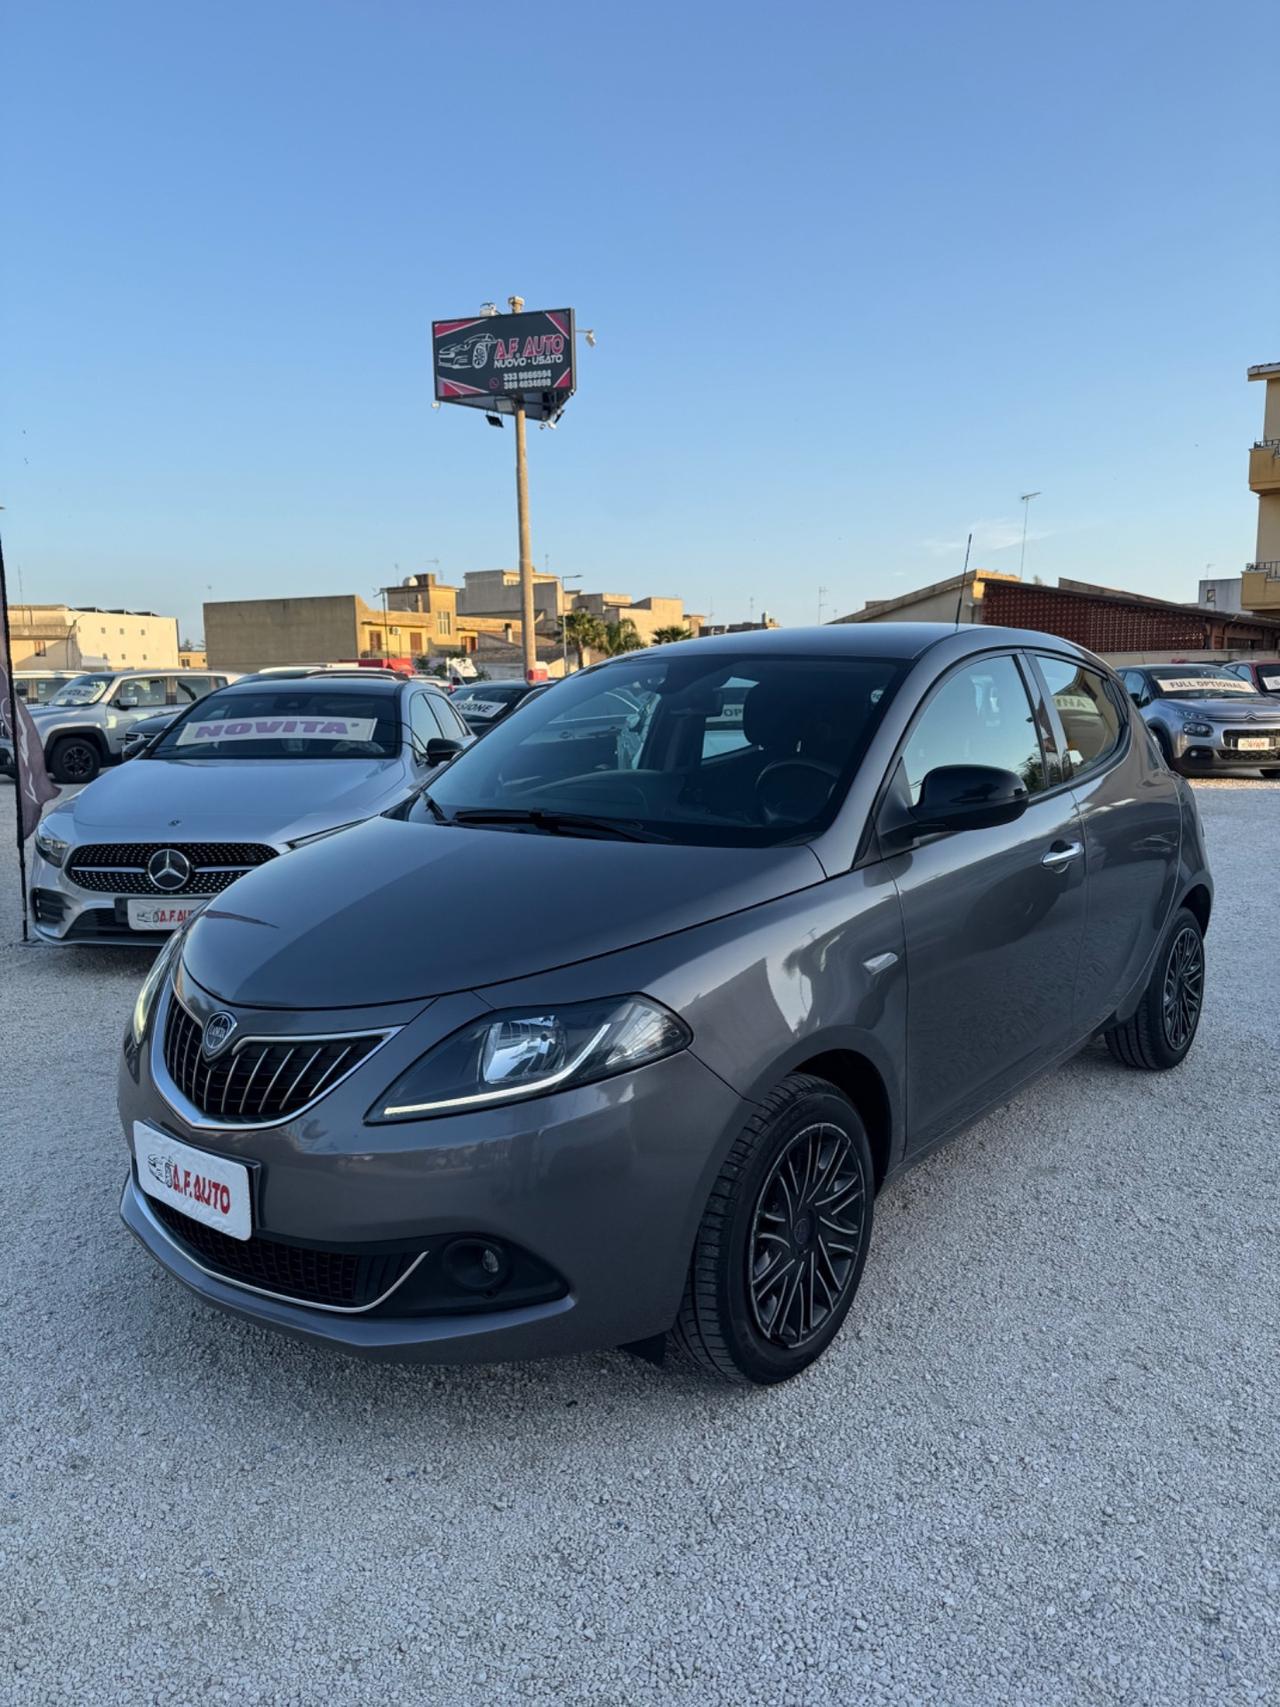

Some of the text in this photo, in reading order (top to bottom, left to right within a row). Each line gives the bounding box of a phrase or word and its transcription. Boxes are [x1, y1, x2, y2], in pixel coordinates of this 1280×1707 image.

[522, 334, 564, 358] AUTO
[494, 354, 563, 368] NUOVO USATO
[1197, 680, 1246, 690] OPTIONAL
